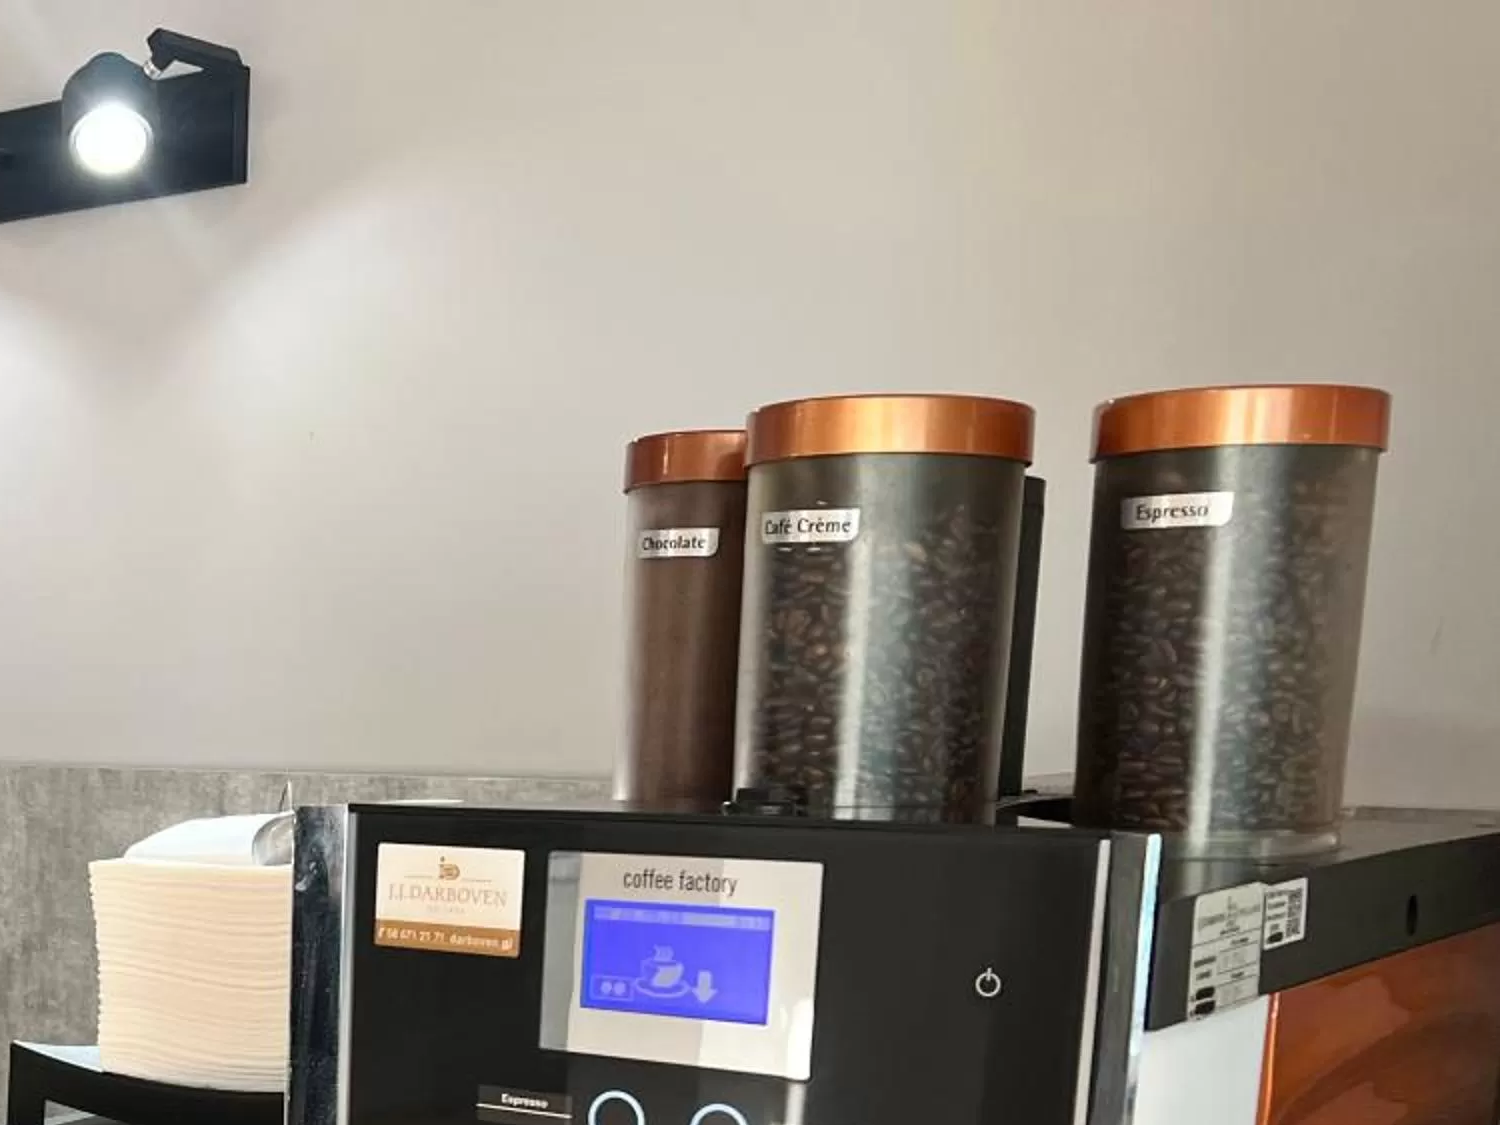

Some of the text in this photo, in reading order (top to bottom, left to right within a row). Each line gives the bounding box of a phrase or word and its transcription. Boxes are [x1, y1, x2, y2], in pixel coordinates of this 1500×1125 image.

[1136, 503, 1209, 524] Espresso
[764, 516, 852, 535] Café Crème
[642, 535, 706, 551] Chocolate
[623, 868, 738, 897] coffee factory
